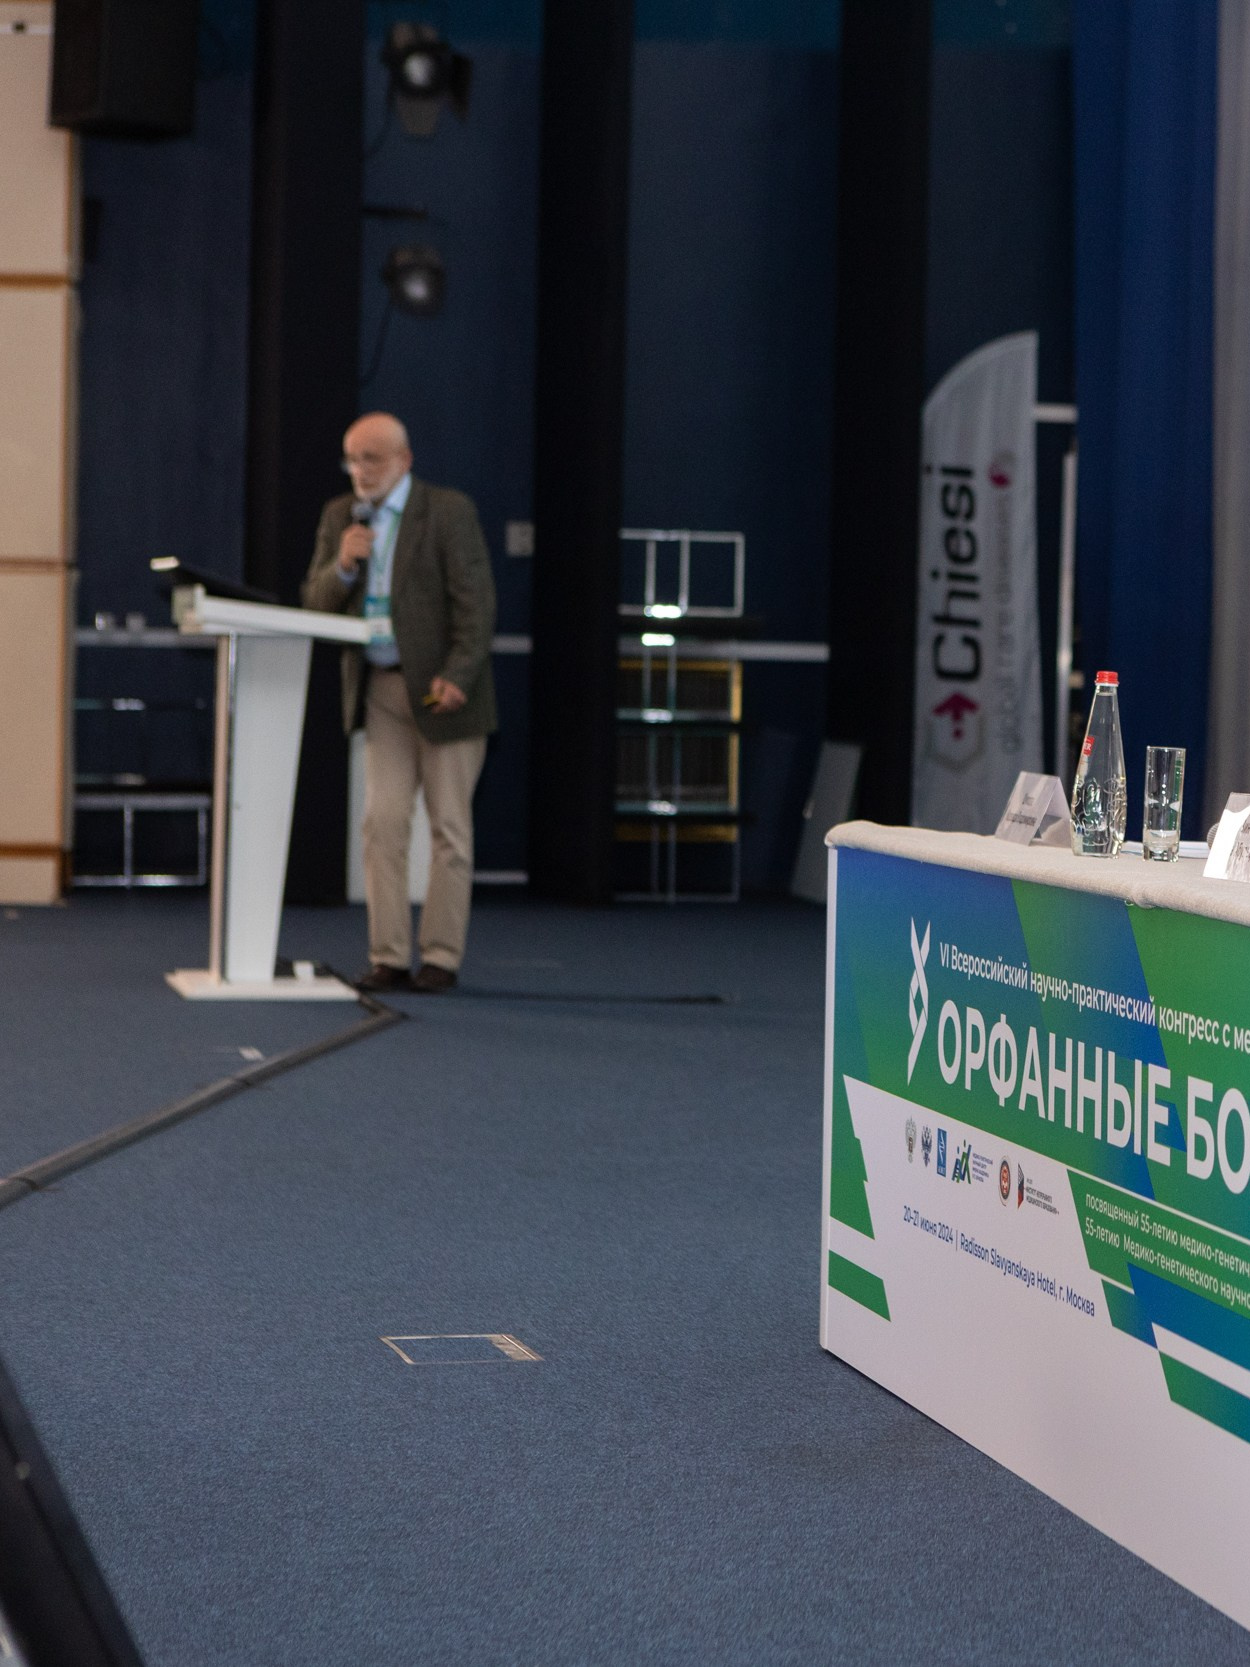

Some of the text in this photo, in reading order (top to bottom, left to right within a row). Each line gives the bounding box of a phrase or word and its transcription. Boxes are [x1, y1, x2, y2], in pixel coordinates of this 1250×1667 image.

[924, 464, 983, 685] Chiesi
[940, 942, 949, 968] VI
[951, 945, 1028, 991] Всероссийский
[1030, 970, 1156, 1026] научно-практический
[1158, 1005, 1219, 1045] конгресс
[1222, 1023, 1231, 1048] с
[937, 999, 1171, 1167] ОРФАННЫЕ
[920, 1216, 937, 1235] июня
[938, 1222, 954, 1244] 2024
[960, 1233, 990, 1262] Radisson
[990, 1248, 1035, 1288] Slavyanskaya
[1036, 1270, 1058, 1301] Hotel,
[1066, 1285, 1095, 1317] Москва
[1085, 1193, 1139, 1229] посвященный
[1140, 1213, 1178, 1246] 55-летию
[1085, 1217, 1120, 1249] 55-летию
[1123, 1233, 1219, 1294] Медико-генетического
